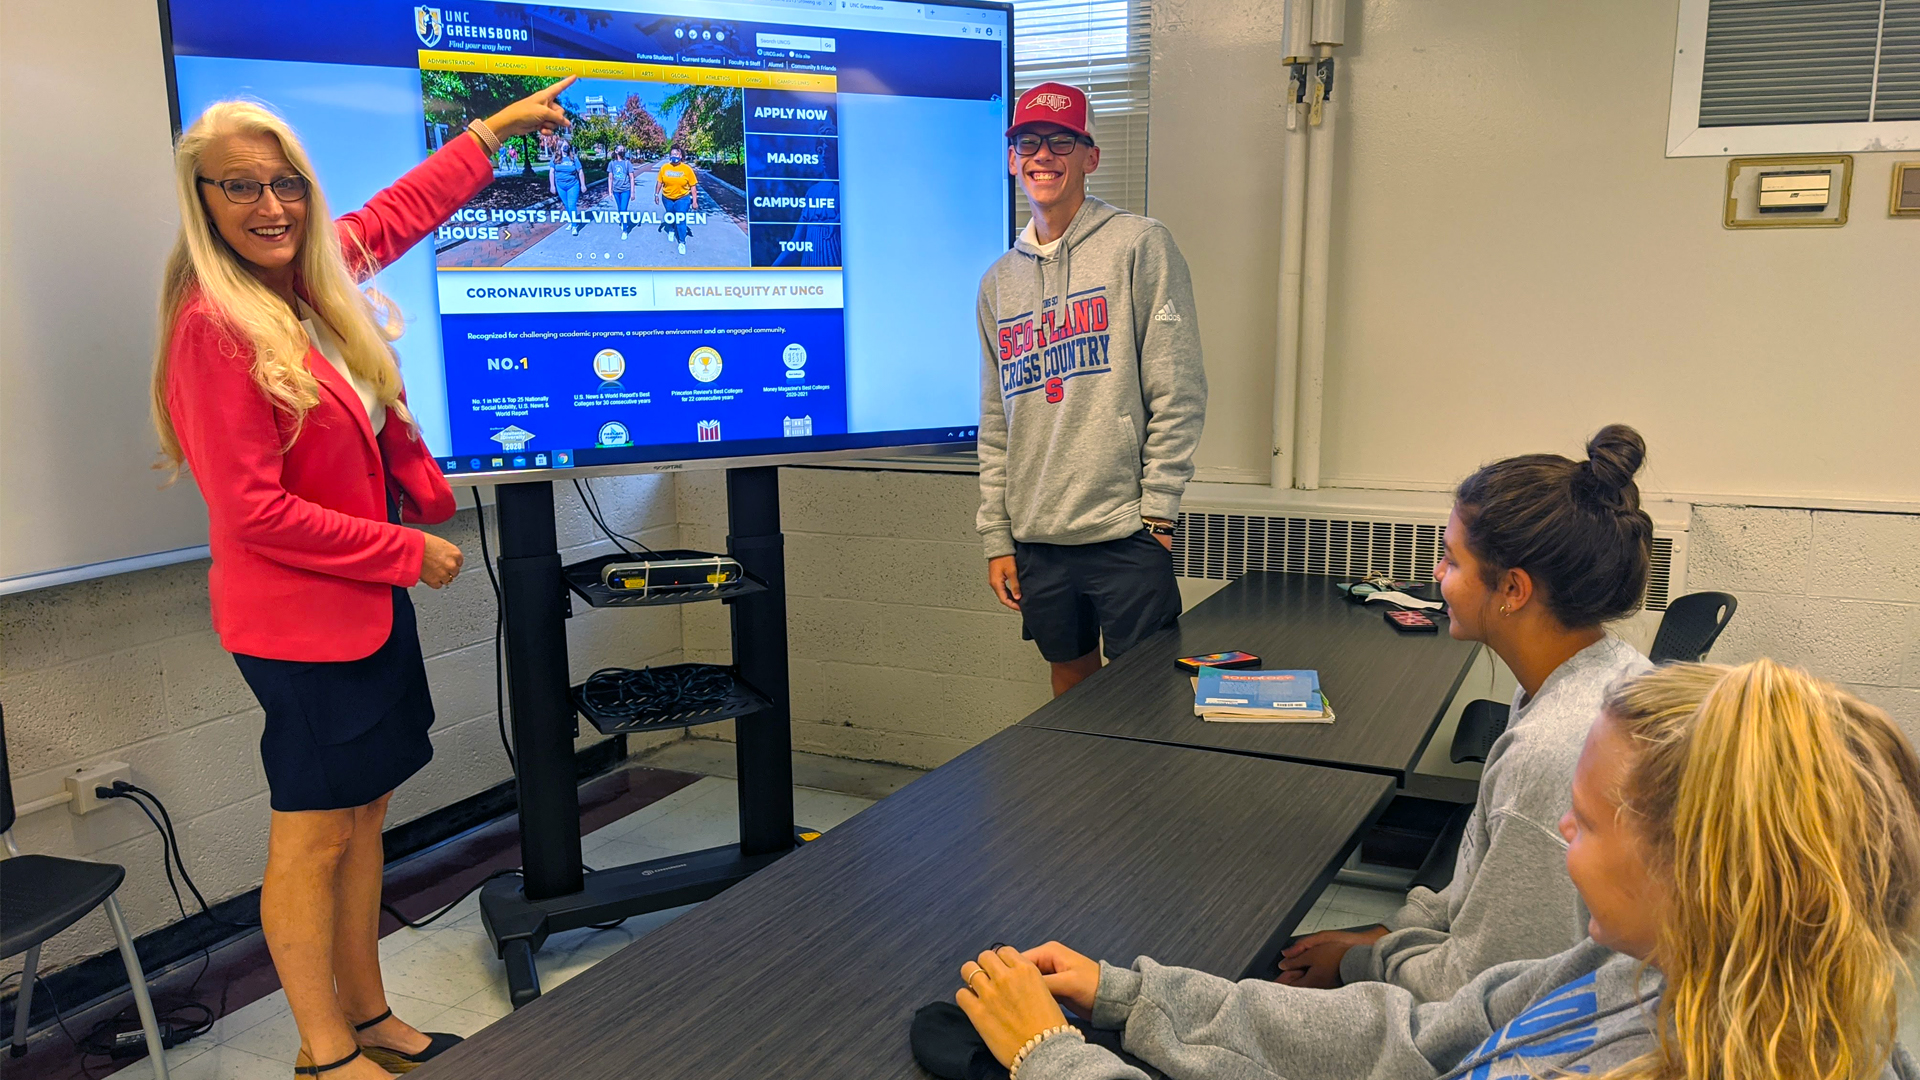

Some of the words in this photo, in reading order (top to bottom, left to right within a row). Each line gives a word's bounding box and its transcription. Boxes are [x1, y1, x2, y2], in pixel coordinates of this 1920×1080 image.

[860, 3, 884, 11] Greensboro
[445, 10, 469, 23] UNC
[446, 24, 528, 41] GREENSBORO
[448, 40, 463, 50] Find
[464, 43, 480, 52] your
[481, 43, 495, 53] way
[497, 43, 512, 52] here
[427, 58, 475, 66] ADMINISTRATION
[651, 53, 674, 62] Students
[728, 59, 745, 68] Faculty
[791, 63, 815, 71] Community
[754, 107, 794, 119] APPLY
[796, 108, 828, 121] NOW
[767, 152, 819, 165] MAJORS
[753, 196, 806, 209] CAMPUS
[808, 197, 835, 209] LIFE
[450, 209, 487, 222] NCG
[491, 210, 547, 223] HOSTS
[550, 210, 591, 223] FALL
[592, 211, 661, 224] VIRTUAL
[664, 212, 707, 225] OPEN
[438, 226, 499, 240] HOUSE
[779, 240, 813, 252] TOUR
[466, 286, 571, 299] CORONAVIRUS
[574, 286, 637, 298] UPDATES
[675, 286, 723, 297] RACIAL
[725, 285, 766, 297] EQUITY
[768, 285, 787, 296] AT
[789, 285, 824, 296] UNCG
[1154, 312, 1181, 321] adidas
[467, 332, 507, 341] Recognized
[519, 331, 558, 340] challenging
[559, 330, 591, 338] academic
[592, 330, 625, 339] programs,
[632, 328, 665, 337] supportive
[726, 327, 752, 336] engaged
[753, 326, 787, 335] community.
[998, 295, 1109, 361] SCOTLAND
[1001, 353, 1041, 392] CROSS
[1044, 334, 1110, 378] COUNTRY
[724, 387, 743, 395] Colleges
[778, 385, 801, 393] Magazine's
[812, 384, 830, 392] Colleges
[1045, 376, 1064, 404] S
[507, 397, 517, 405] Top
[525, 396, 549, 404] Nationally
[620, 392, 638, 400] Report's
[638, 398, 651, 406] years
[695, 394, 721, 402] consecutive
[721, 394, 734, 402] years
[497, 403, 517, 412] Mobility,
[511, 410, 529, 418] Report
